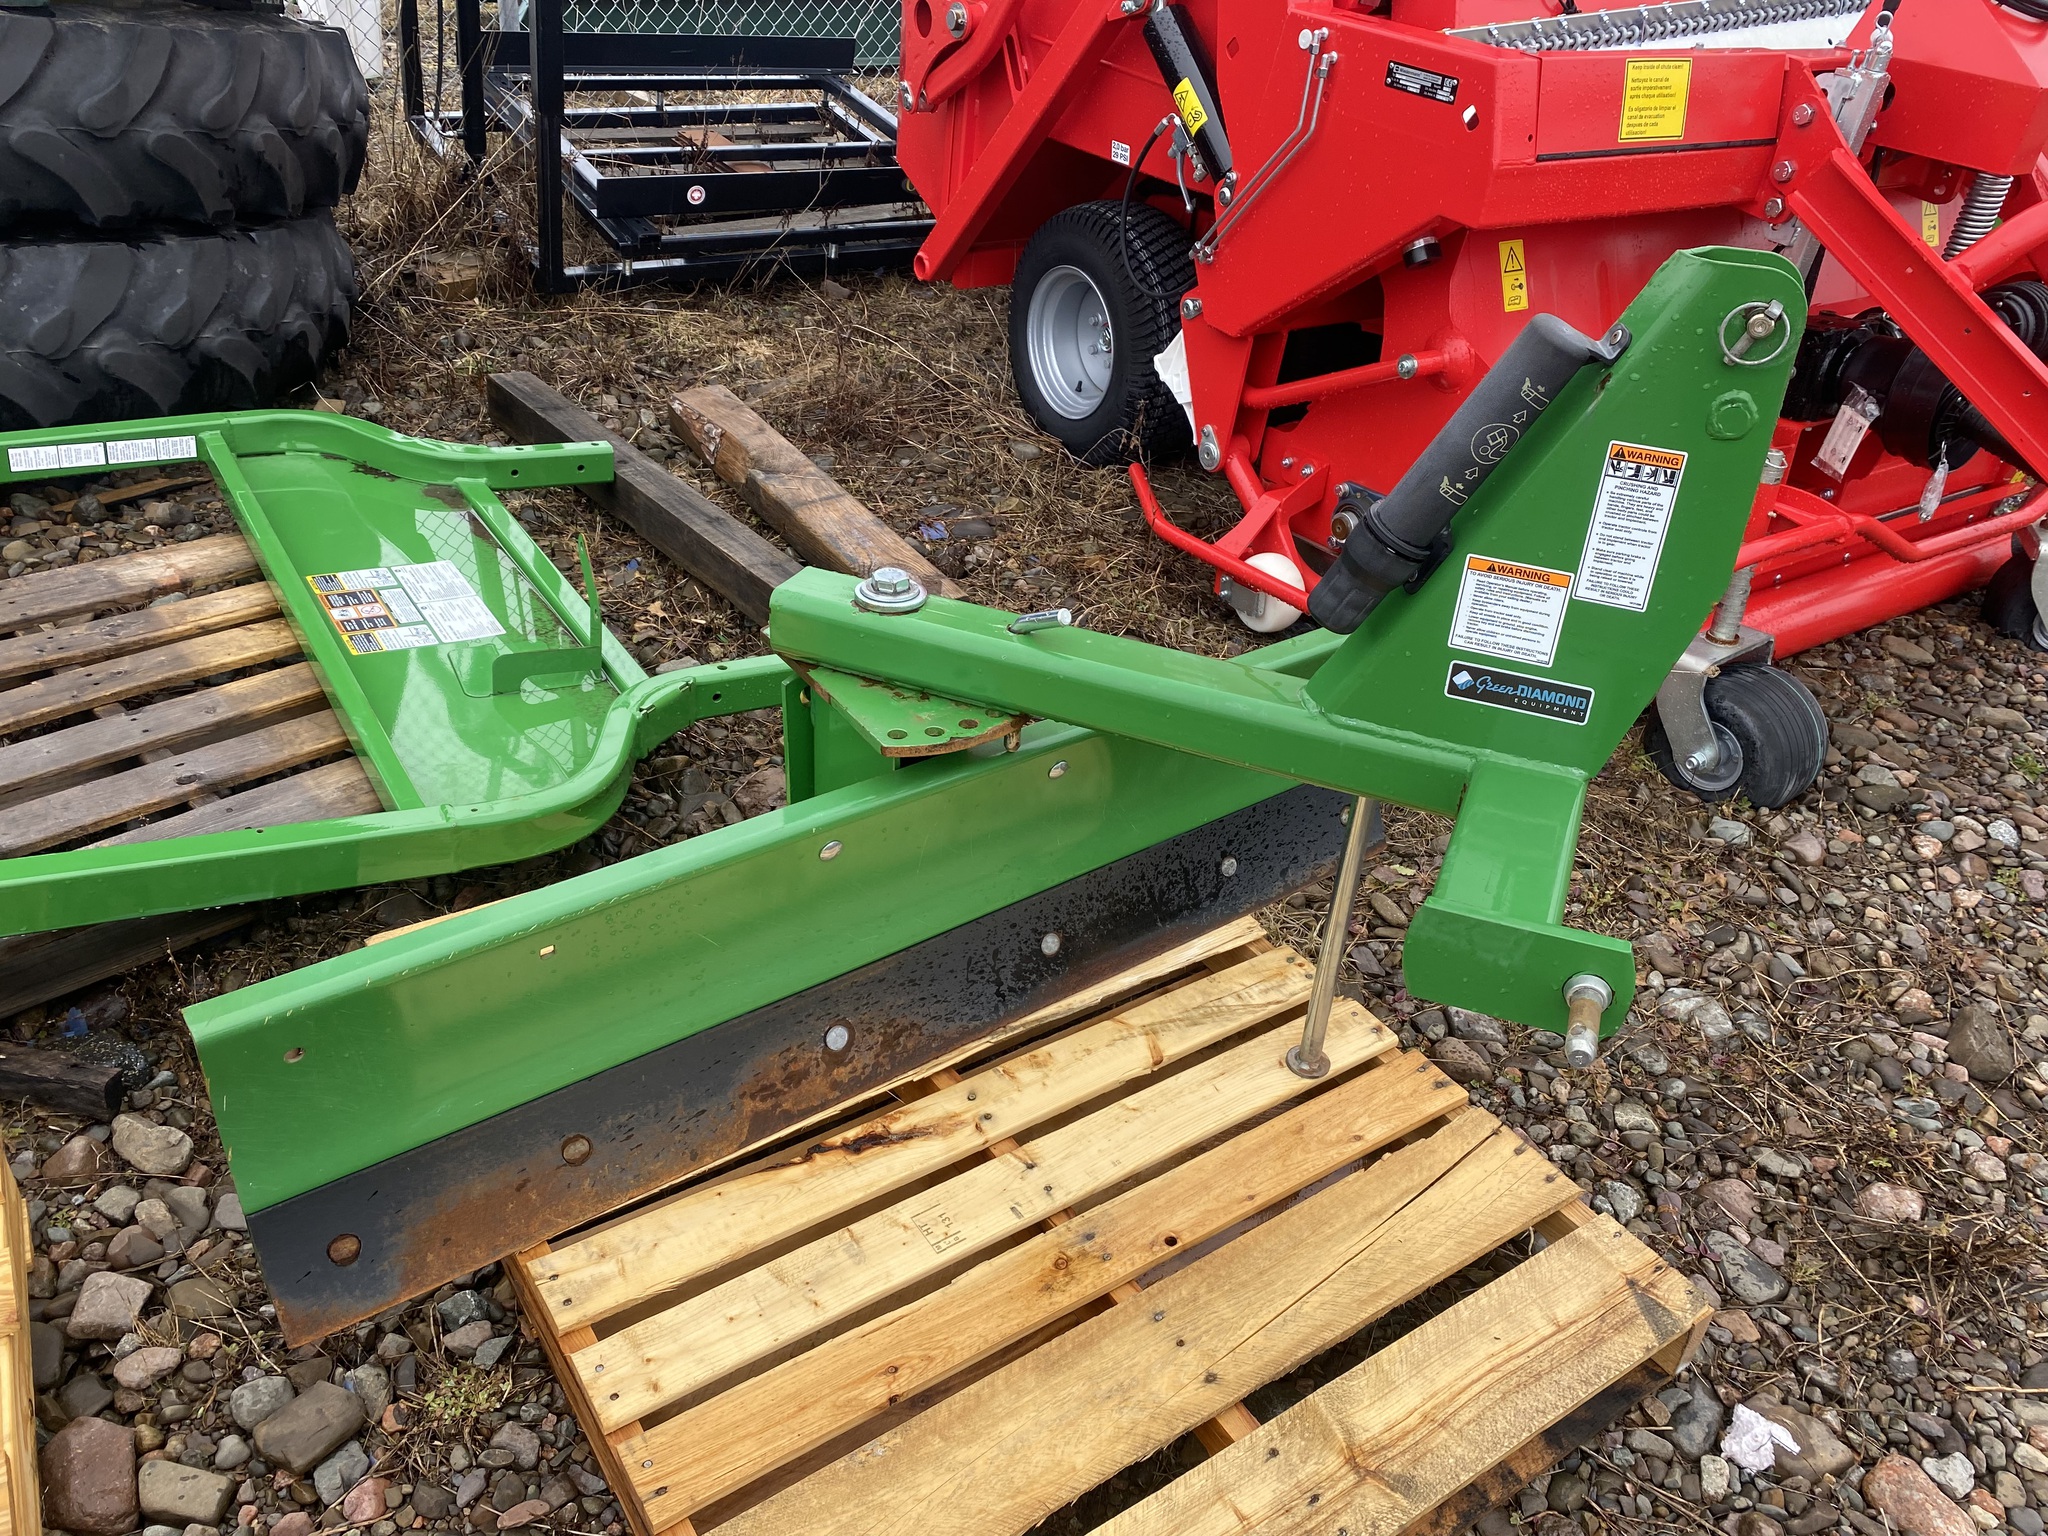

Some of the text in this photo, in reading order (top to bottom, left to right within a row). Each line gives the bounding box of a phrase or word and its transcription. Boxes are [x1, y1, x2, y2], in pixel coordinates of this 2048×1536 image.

[1112, 150, 1128, 162] 29 PSI
[1121, 144, 1129, 153] bar
[1626, 450, 1680, 466] WARNING
[1496, 565, 1551, 583] WARNING
[1516, 684, 1587, 710] DIAMOND
[1514, 698, 1585, 717] EQUIPMENT
[938, 1212, 953, 1228] 131
[918, 1223, 934, 1236] HT
